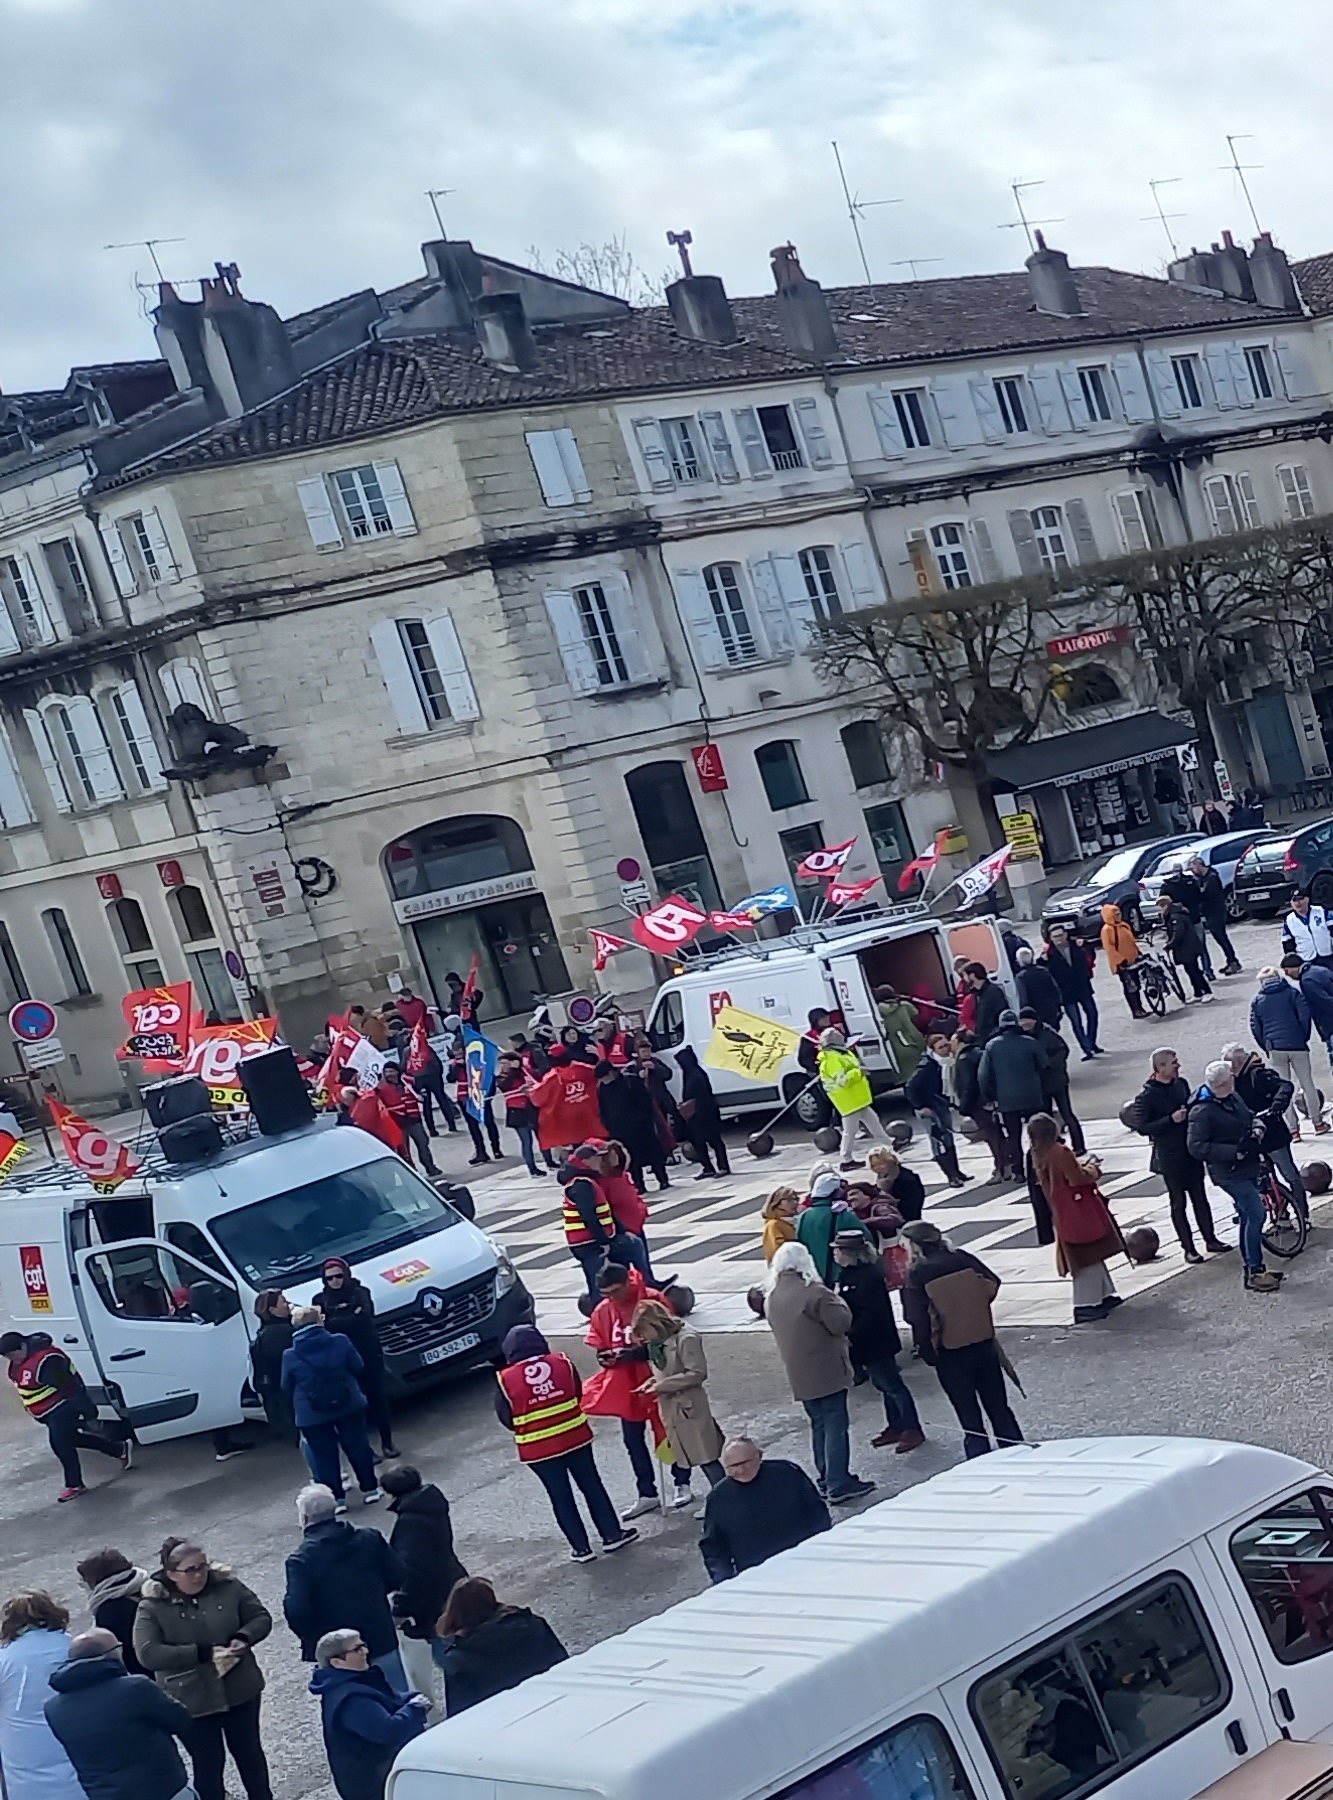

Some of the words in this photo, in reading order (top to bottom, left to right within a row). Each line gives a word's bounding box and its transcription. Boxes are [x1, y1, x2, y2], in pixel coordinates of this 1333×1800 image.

[402, 895, 451, 915] CAISSE
[24, 1266, 46, 1291] cgt
[392, 1262, 420, 1280] cgt
[532, 1379, 555, 1395] cgt
